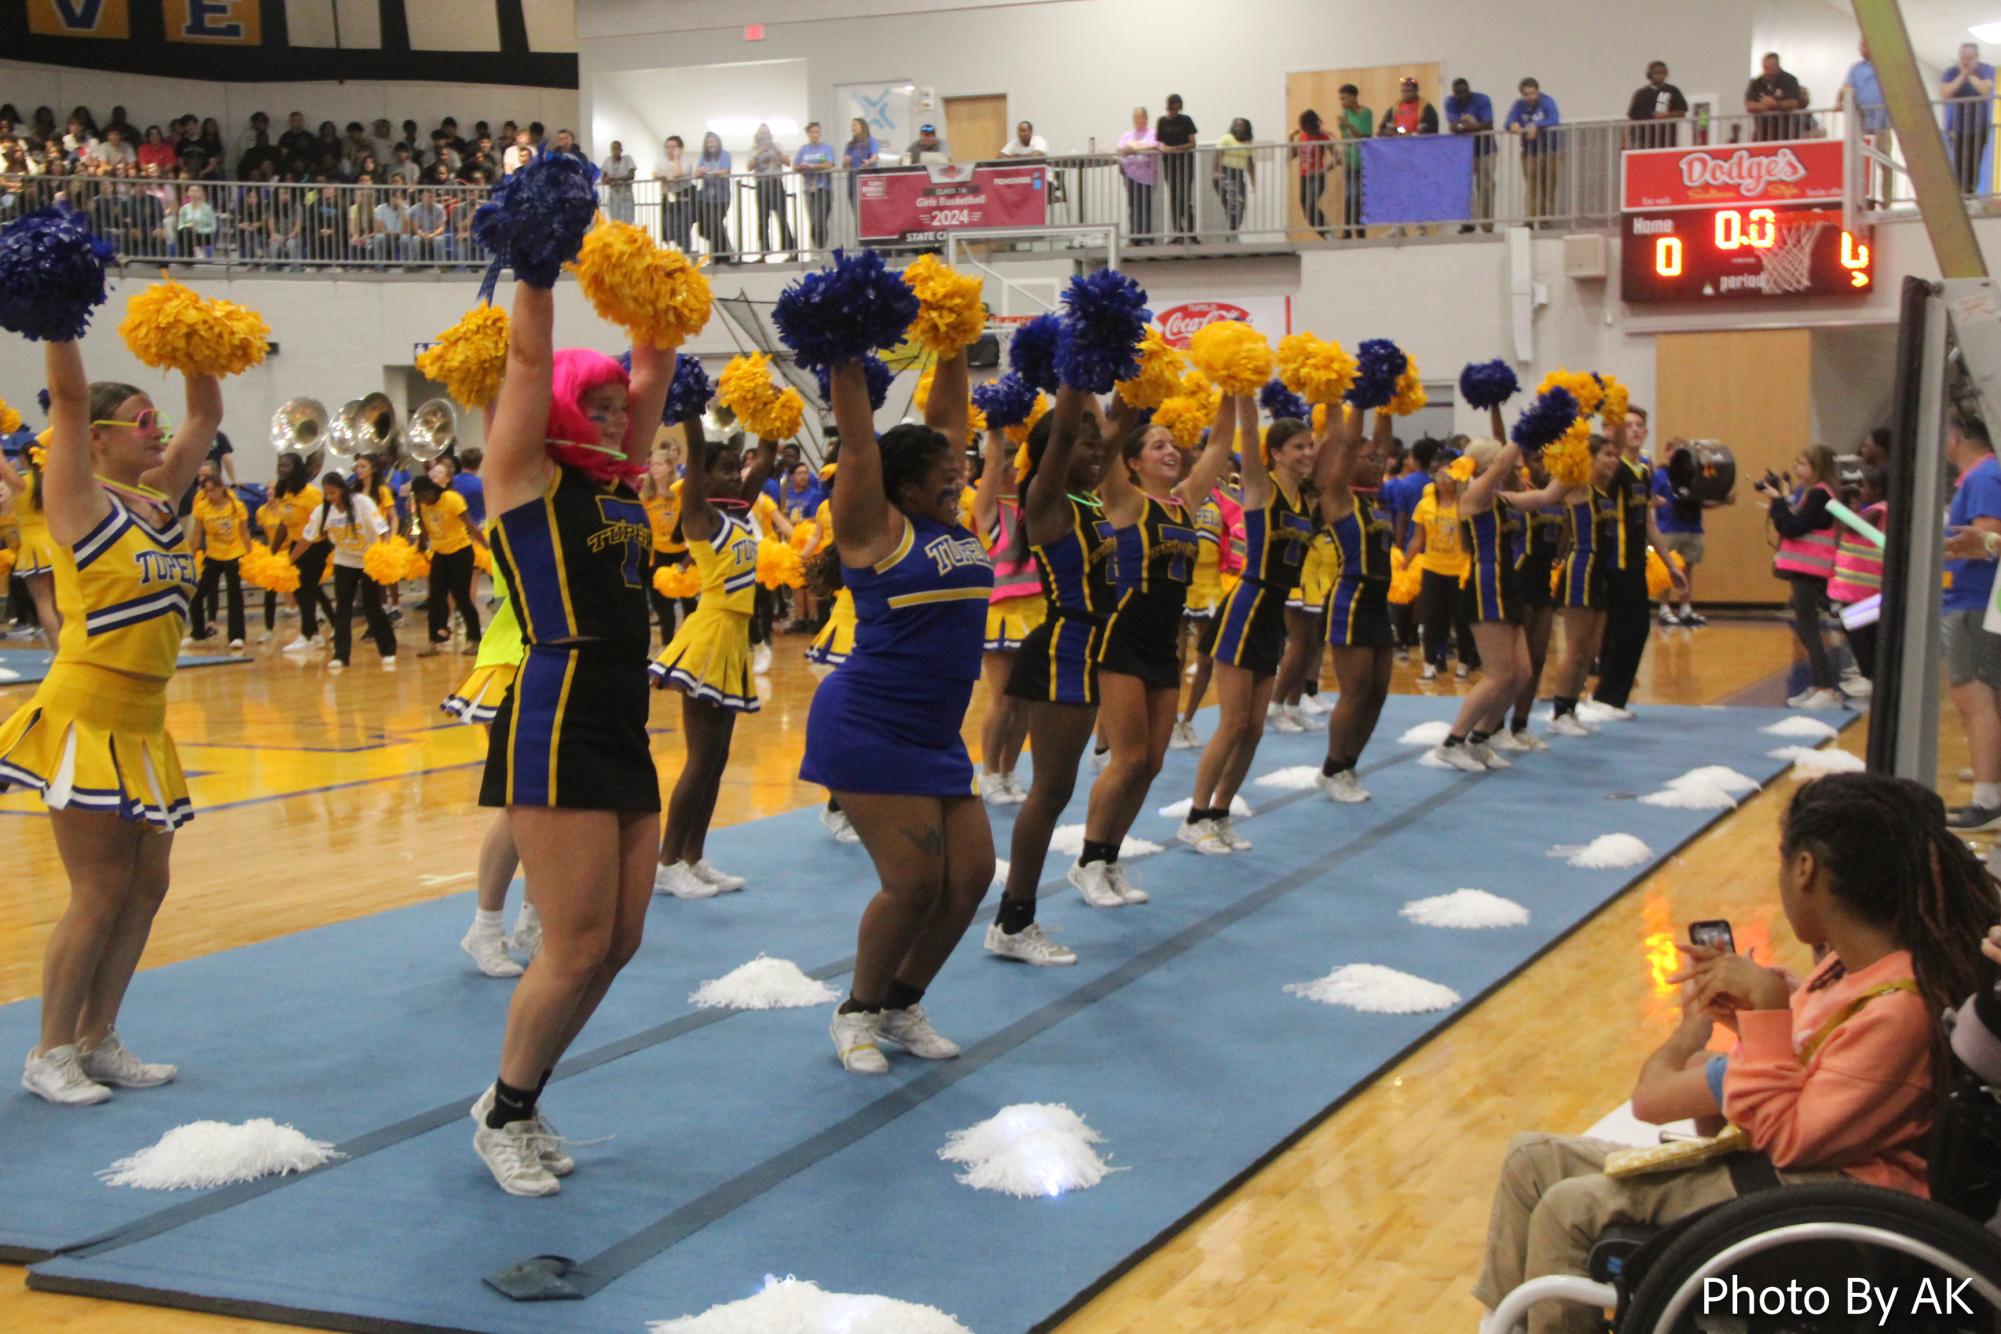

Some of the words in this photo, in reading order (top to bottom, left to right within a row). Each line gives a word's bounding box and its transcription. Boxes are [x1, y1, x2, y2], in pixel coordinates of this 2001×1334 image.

[1679, 148, 1807, 197] Dodge's
[916, 197, 938, 207] Girls
[939, 195, 986, 206] Basketball
[931, 209, 970, 226] 2024
[1633, 216, 1674, 235] Home
[905, 231, 935, 242] STATE
[1655, 236, 1683, 277] 0
[1720, 273, 1767, 293] period
